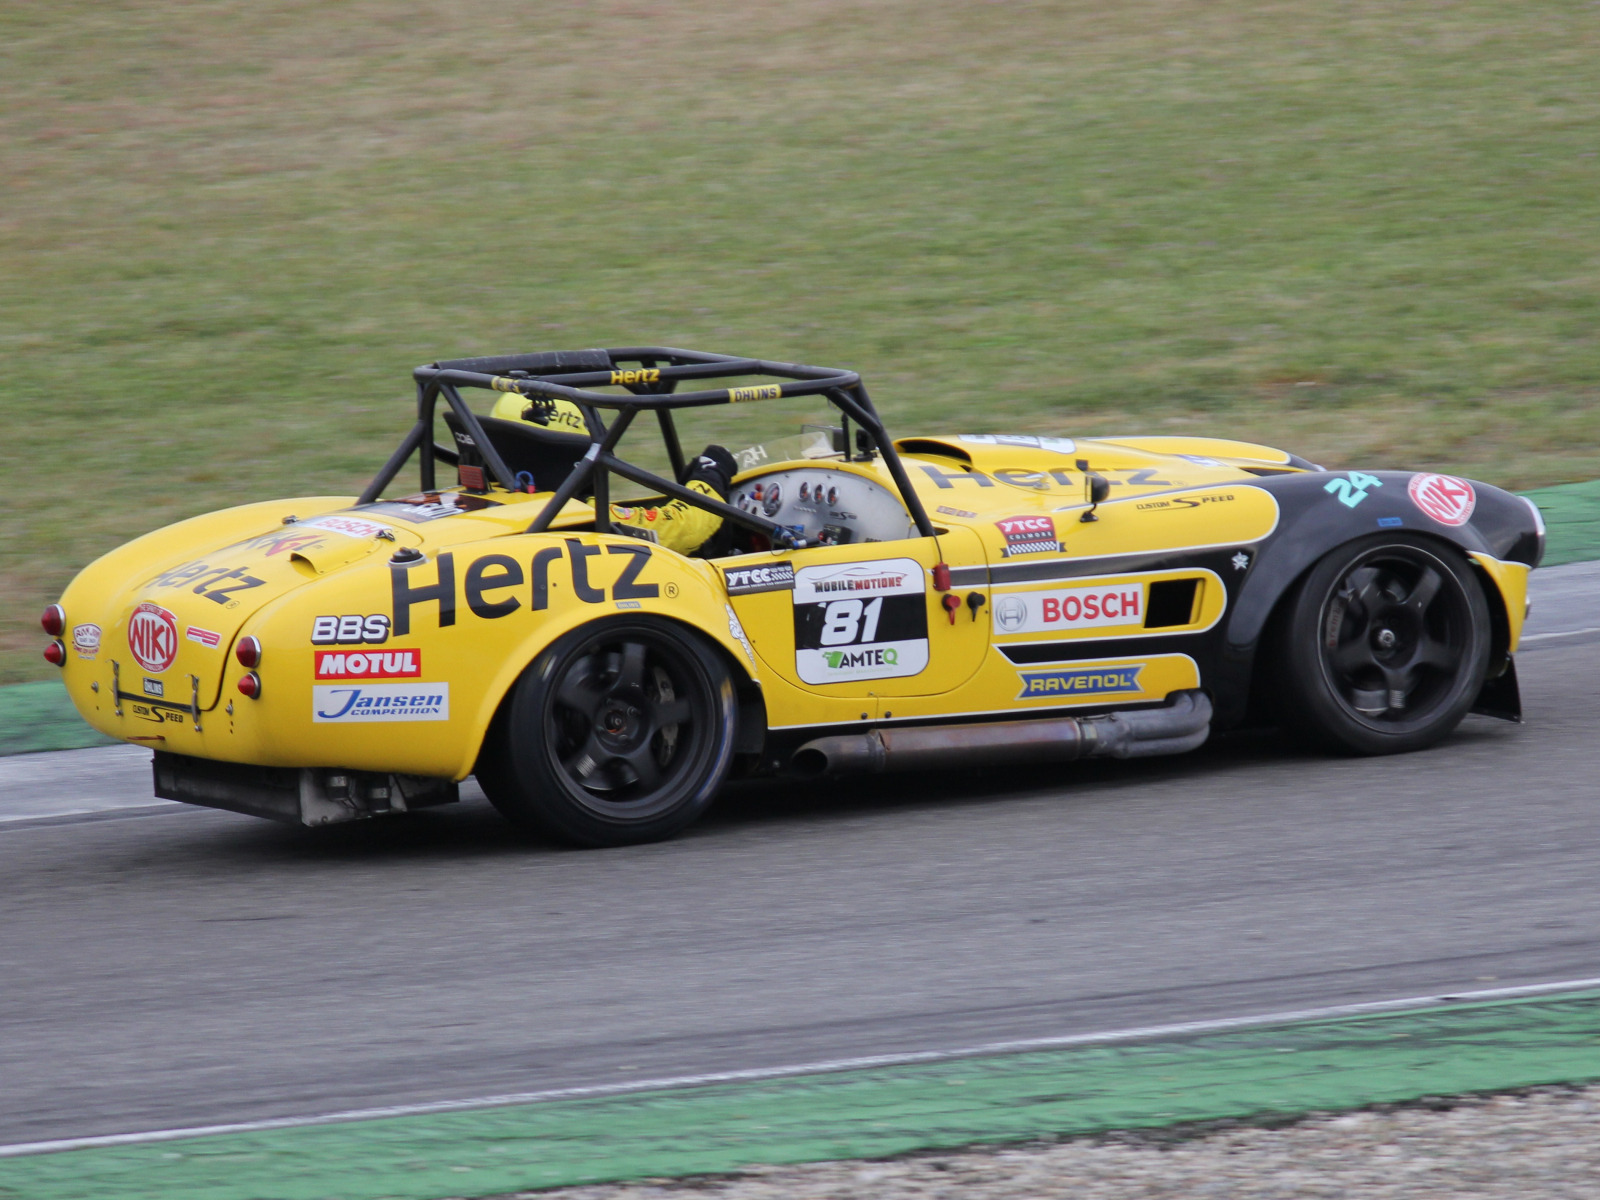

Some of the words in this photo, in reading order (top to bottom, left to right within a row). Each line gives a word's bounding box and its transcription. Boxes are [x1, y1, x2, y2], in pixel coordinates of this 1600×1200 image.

[610, 368, 660, 384] Hertz
[735, 388, 777, 401] ÖHLINS
[548, 409, 581, 429] ertz
[1323, 471, 1384, 509] 24
[1172, 494, 1235, 508] SPEED
[314, 518, 380, 537] BOSCH
[1000, 518, 1050, 532] YTCC
[132, 560, 267, 605] Hertz
[390, 538, 660, 637] Hertz
[726, 568, 771, 587] YTCC
[1042, 591, 1139, 623] BOSCH
[311, 614, 391, 645] BBS
[820, 596, 883, 646] 81
[131, 618, 171, 661] NIKI
[319, 652, 417, 674] MOTUL
[839, 648, 898, 668] AMTEQ
[1029, 674, 1132, 692] RAVENOL
[317, 689, 443, 719] Jansen
[350, 707, 440, 716] COMPETITION
